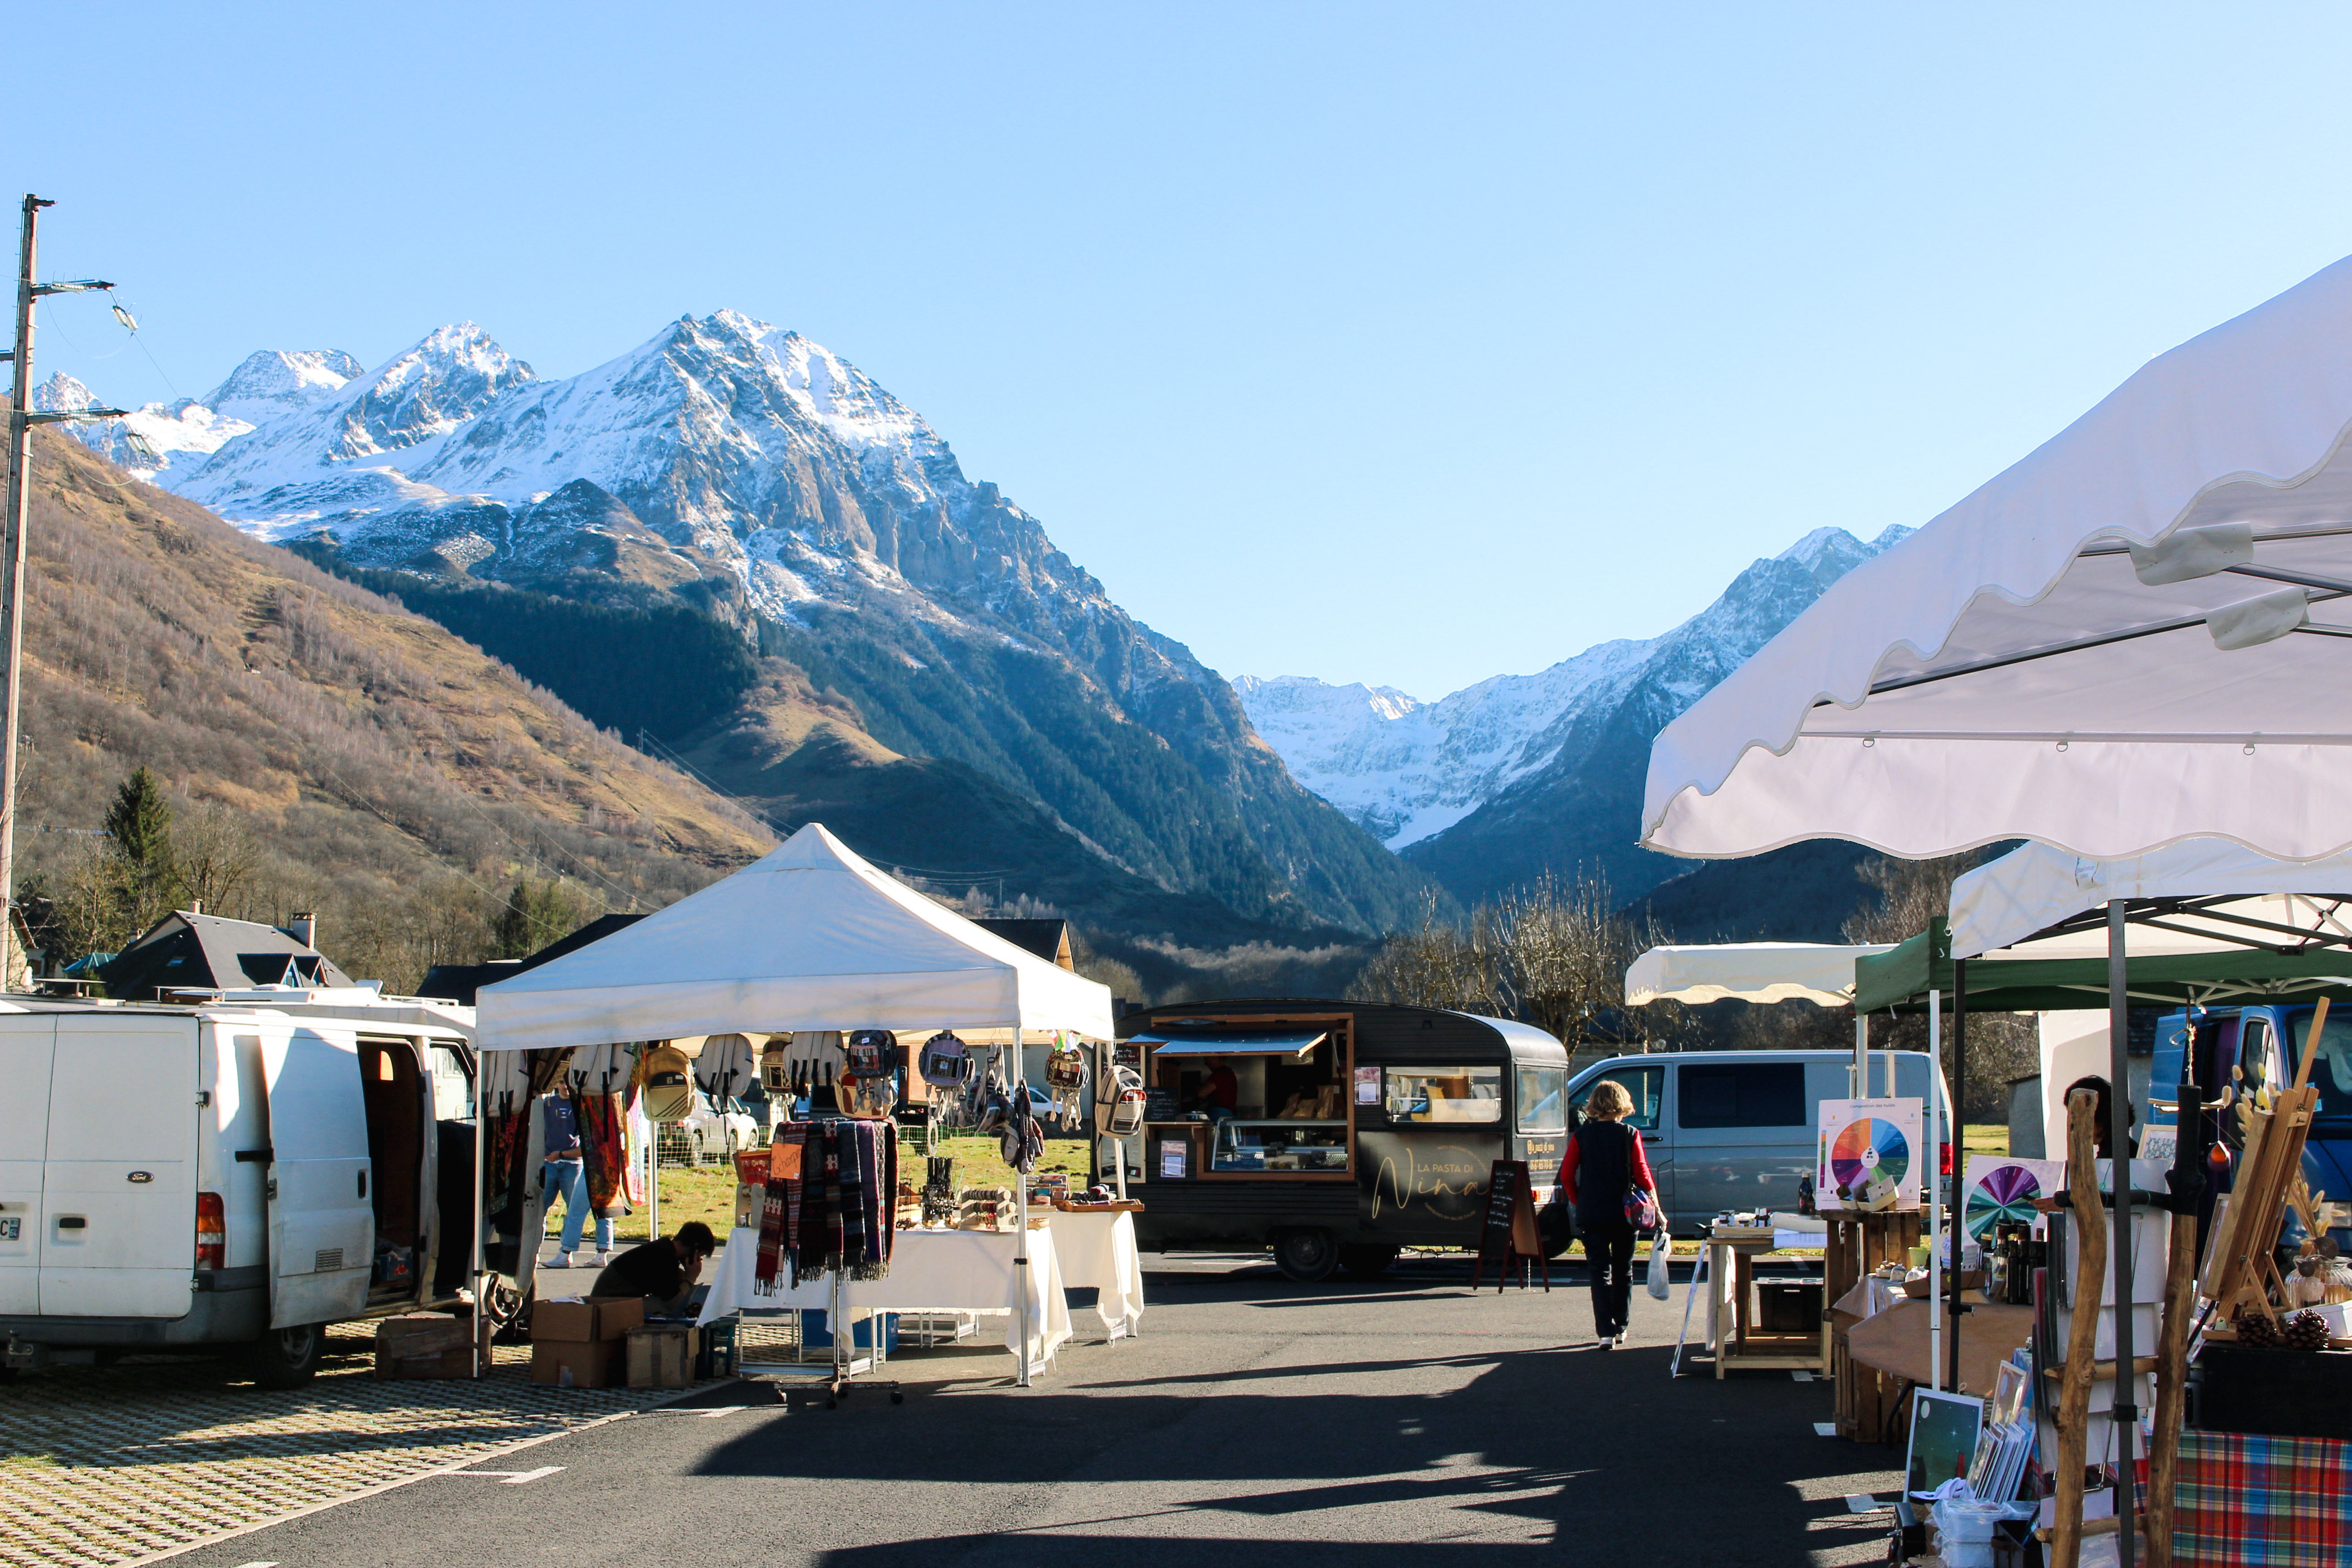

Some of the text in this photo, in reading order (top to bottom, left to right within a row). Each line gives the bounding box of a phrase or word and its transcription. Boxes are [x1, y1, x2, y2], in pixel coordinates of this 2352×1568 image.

[1417, 1164, 1430, 1172] LA
[1432, 1164, 1461, 1173] PASTA
[1464, 1164, 1473, 1173] DI
[1372, 1147, 1489, 1219] Nina
[0, 1220, 9, 1236] C
